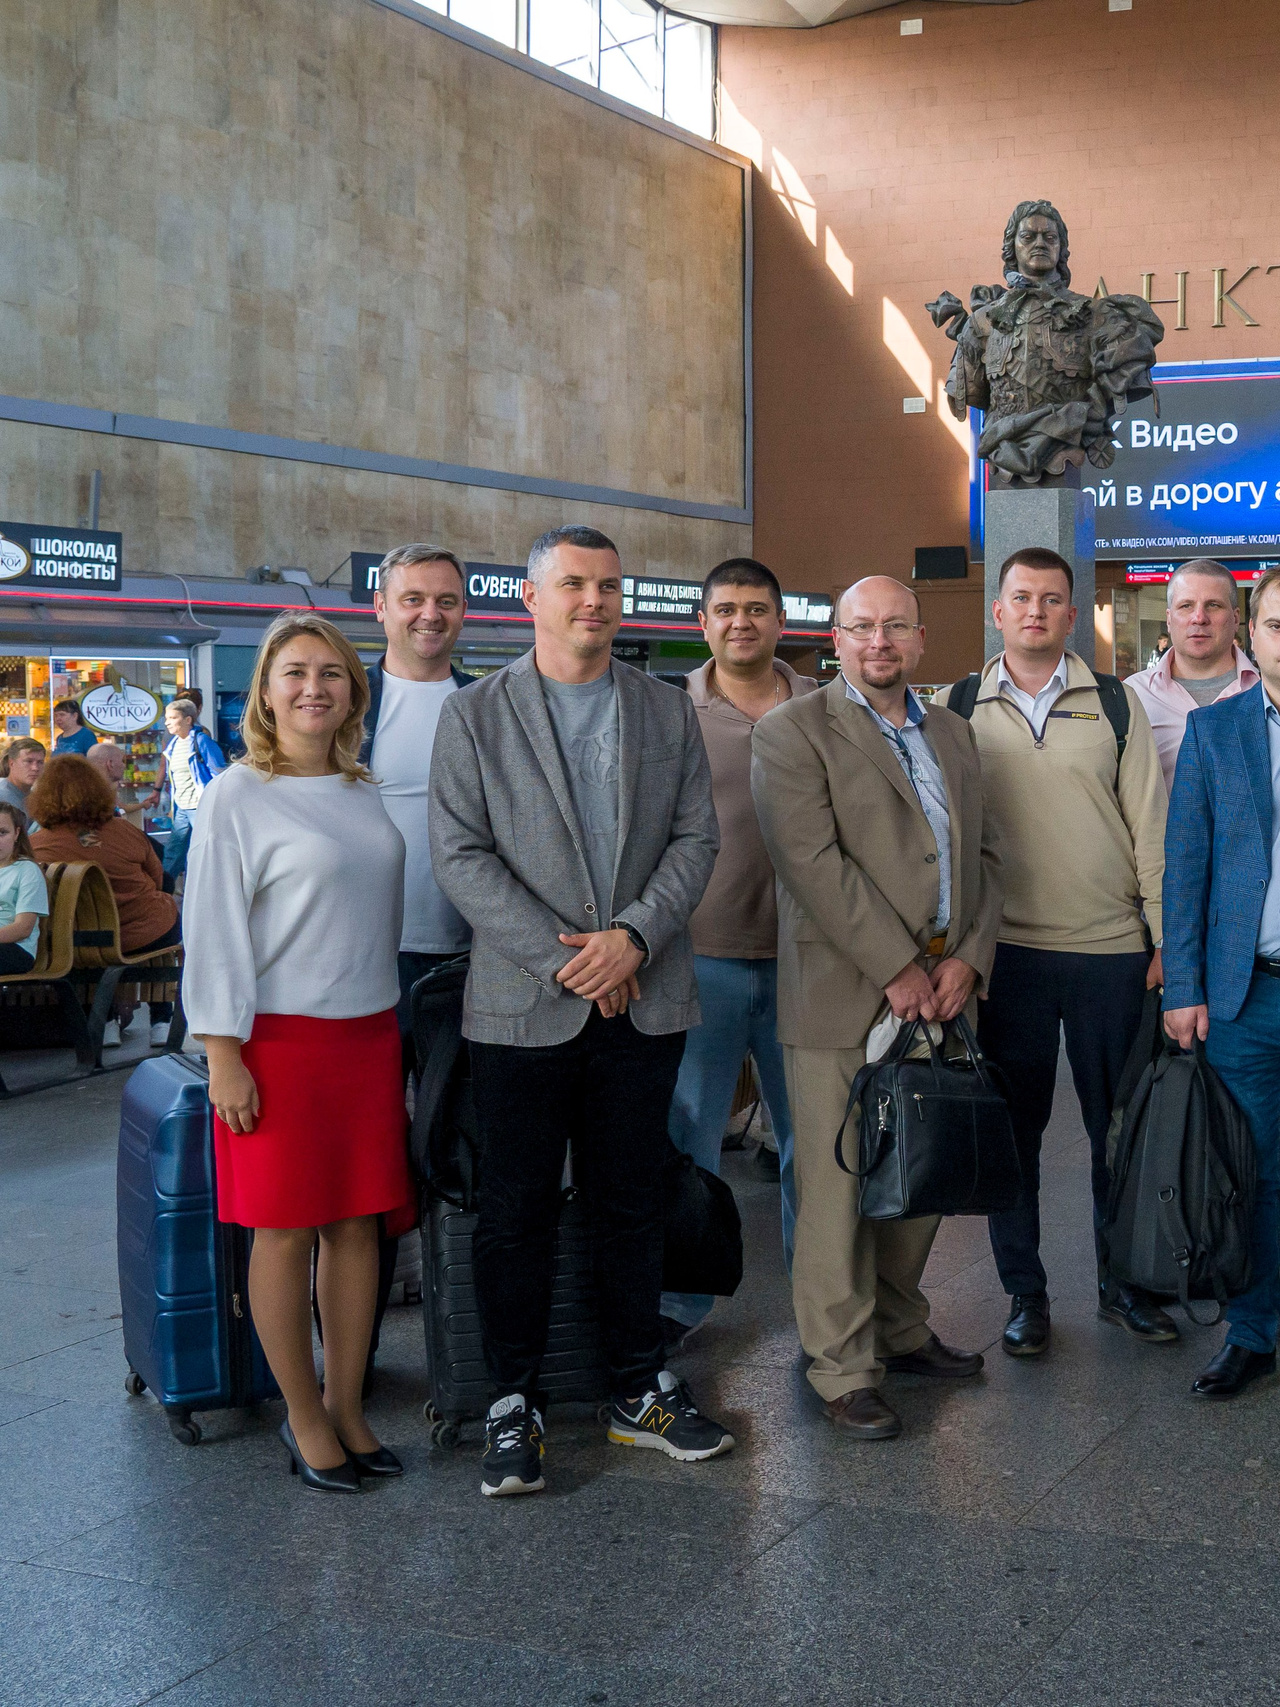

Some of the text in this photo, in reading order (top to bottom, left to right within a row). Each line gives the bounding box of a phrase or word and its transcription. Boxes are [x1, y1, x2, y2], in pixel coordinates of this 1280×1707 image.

[1131, 420, 1238, 451] Видео
[1126, 485, 1143, 506] в
[1150, 481, 1267, 510] дорогу
[33, 538, 117, 564] ШОКОЛАД
[1121, 538, 1144, 549] ВИДЕО
[1145, 536, 1198, 548] (VK.COM/VIDEO)
[1200, 534, 1248, 546] СОГЛАШЕНИЕ:
[34, 559, 116, 581] КОНФЕТЫ
[637, 582, 657, 597] АВИА
[657, 584, 663, 598] И
[663, 584, 679, 600] Ж/Д
[637, 601, 657, 613] AIRLINE
[661, 603, 675, 614] TRAIN
[675, 604, 693, 615] TICKETS
[87, 703, 153, 724] КРУПСКОЙ
